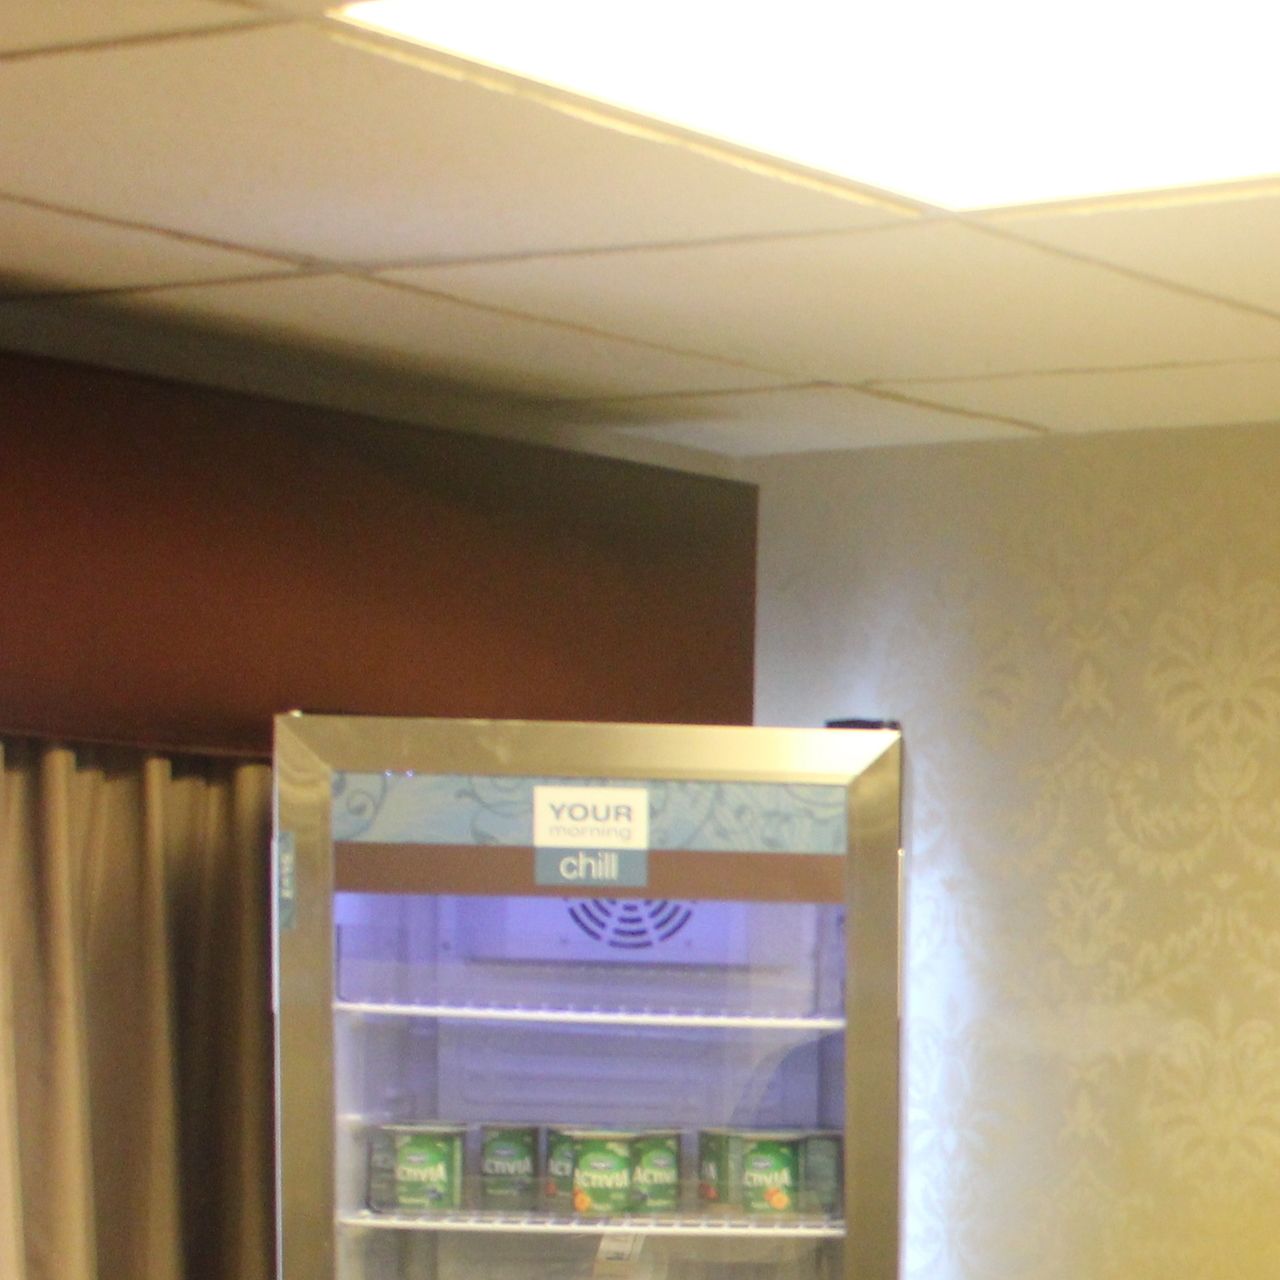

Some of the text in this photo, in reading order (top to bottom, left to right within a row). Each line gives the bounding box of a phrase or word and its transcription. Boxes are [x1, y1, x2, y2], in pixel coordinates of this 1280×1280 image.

[550, 803, 632, 822] YOUR
[550, 825, 632, 840] morning
[559, 852, 619, 880] chill
